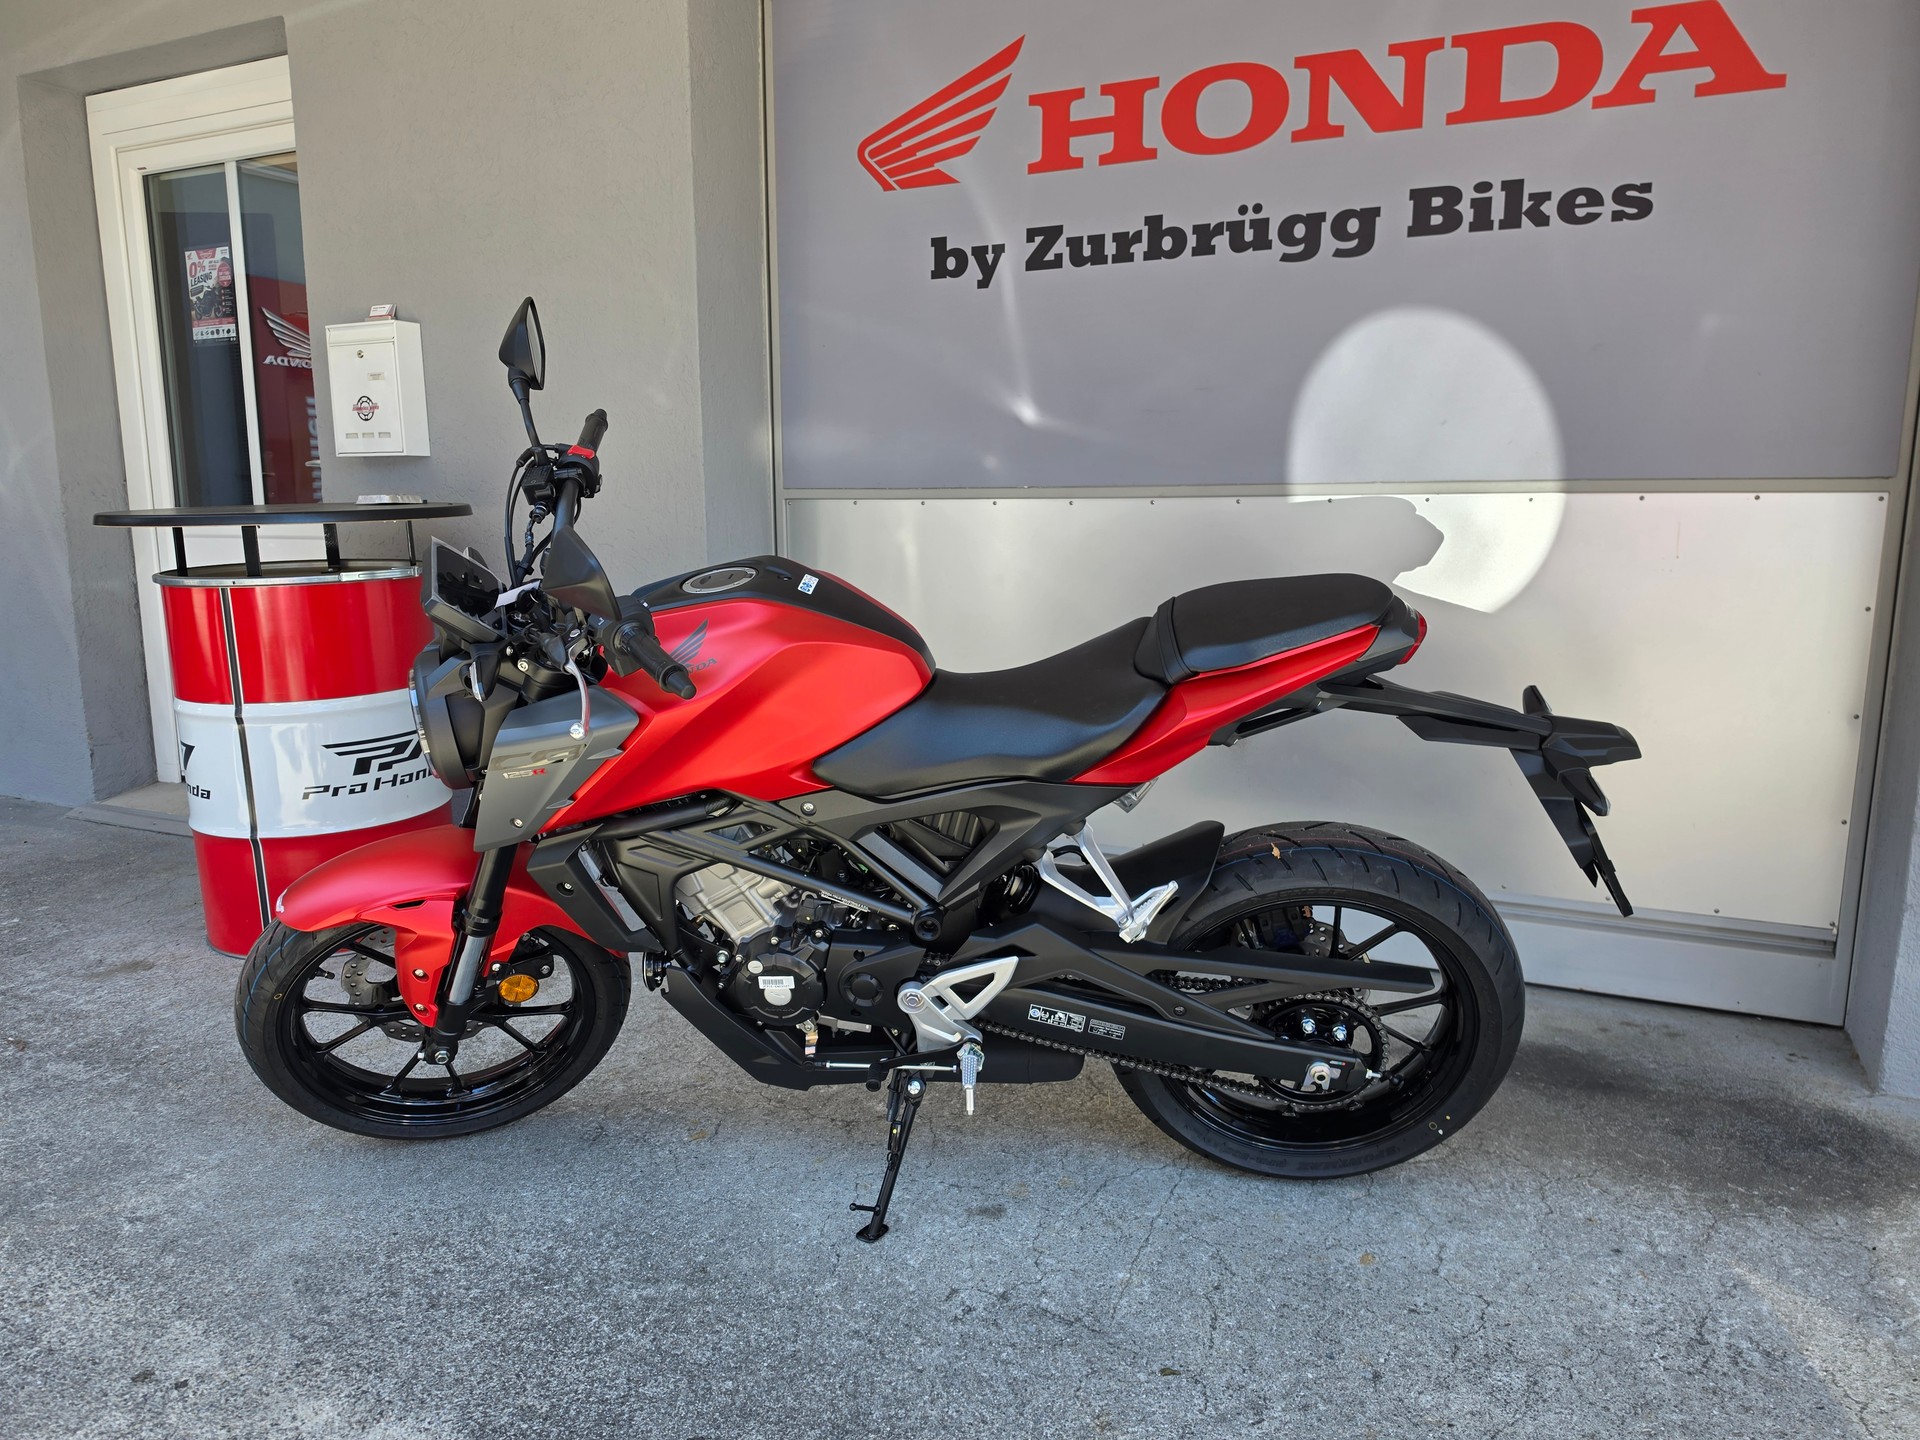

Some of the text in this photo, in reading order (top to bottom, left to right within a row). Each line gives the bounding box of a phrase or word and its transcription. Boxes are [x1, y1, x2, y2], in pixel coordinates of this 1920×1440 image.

[1027, 0, 1787, 175] HONDA
[930, 178, 1654, 289] by Zurbrügg Bikes
[189, 259, 206, 278] 0%
[191, 271, 213, 287] LEASING
[503, 767, 546, 779] 125R
[302, 782, 368, 801] Pro
